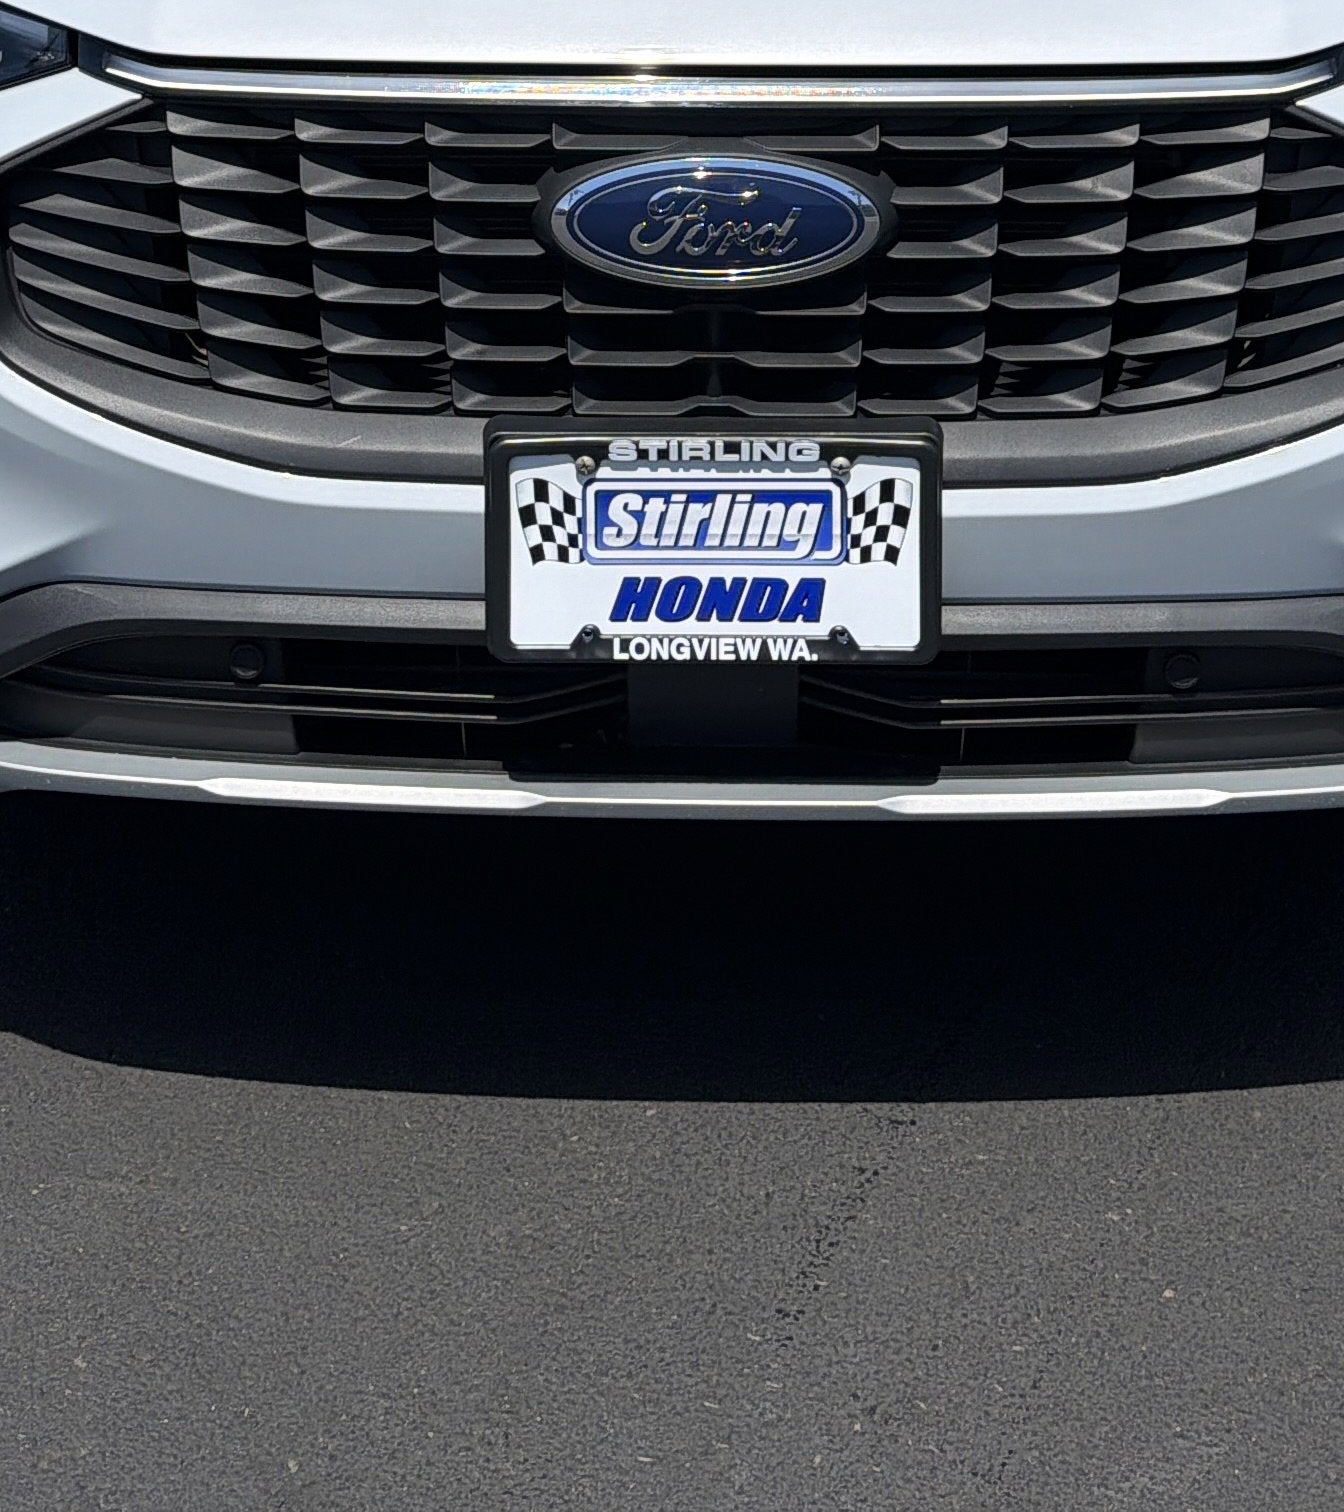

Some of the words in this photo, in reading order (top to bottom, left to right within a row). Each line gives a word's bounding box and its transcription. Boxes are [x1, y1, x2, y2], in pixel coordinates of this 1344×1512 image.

[629, 186, 803, 256] Ford
[608, 438, 820, 463] STIRLING
[602, 492, 824, 559] Stirling
[609, 576, 826, 623] HONDA
[612, 637, 763, 661] LONGVIEW
[767, 637, 818, 661] WA.
